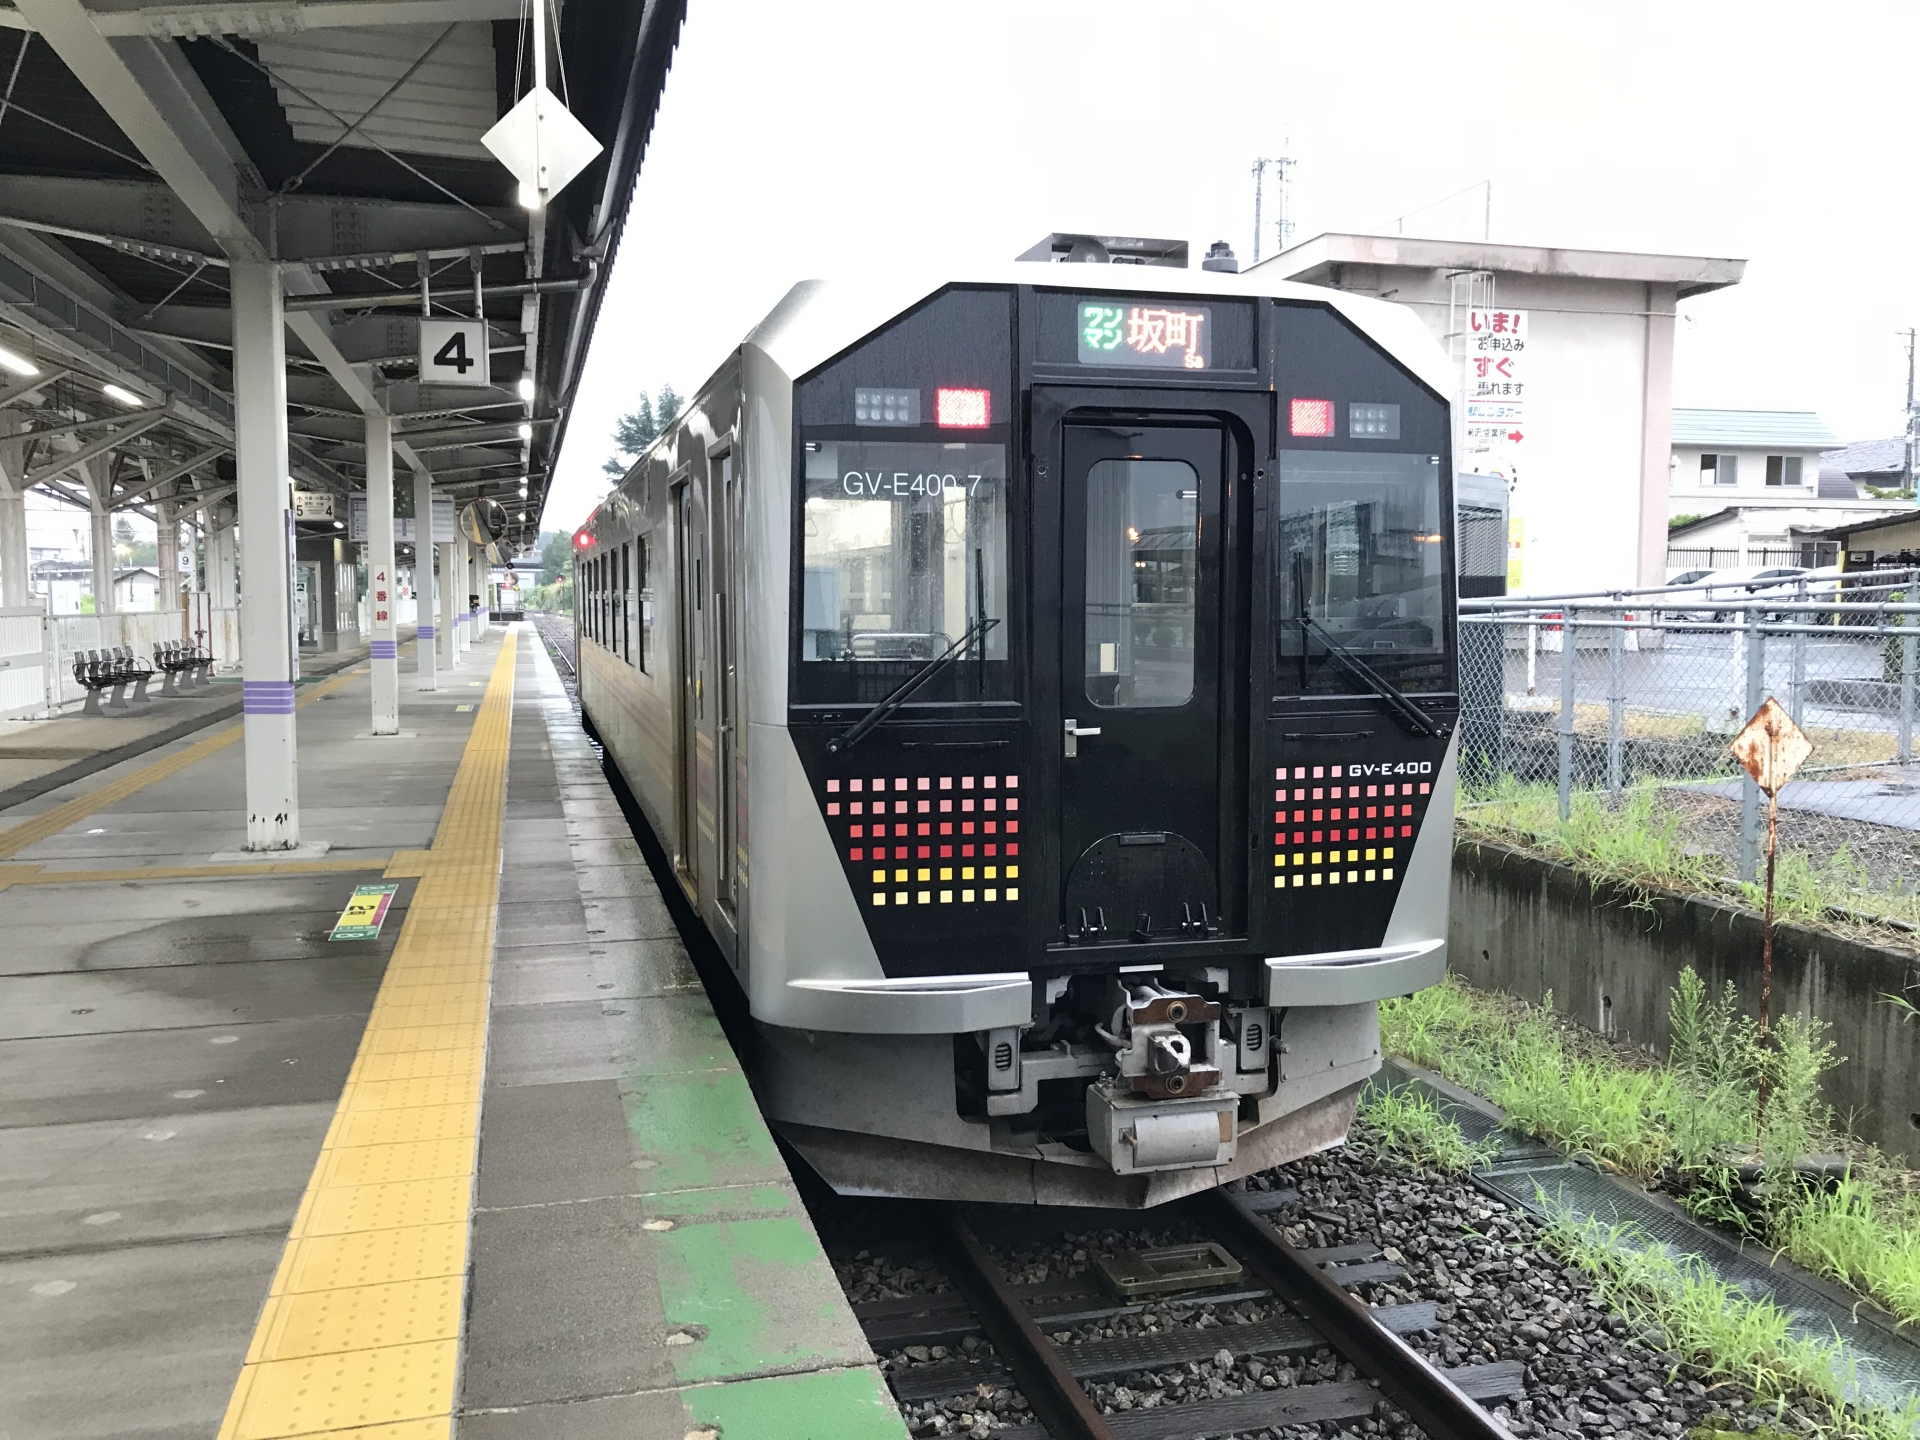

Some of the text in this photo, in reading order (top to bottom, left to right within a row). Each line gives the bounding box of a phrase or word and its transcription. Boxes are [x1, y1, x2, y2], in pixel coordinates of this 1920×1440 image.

[1084, 307, 1204, 354] ワン 坂町
[1471, 312, 1521, 334] いま!
[1084, 328, 1123, 349] マン
[1478, 337, 1525, 352] お申込み
[434, 332, 474, 374] 4
[1473, 356, 1515, 378] すぐ
[296, 504, 304, 517] 5
[325, 505, 333, 517] 4
[182, 556, 190, 566] 9
[376, 571, 388, 621] 4番線
[1349, 762, 1432, 777] GV-E400
